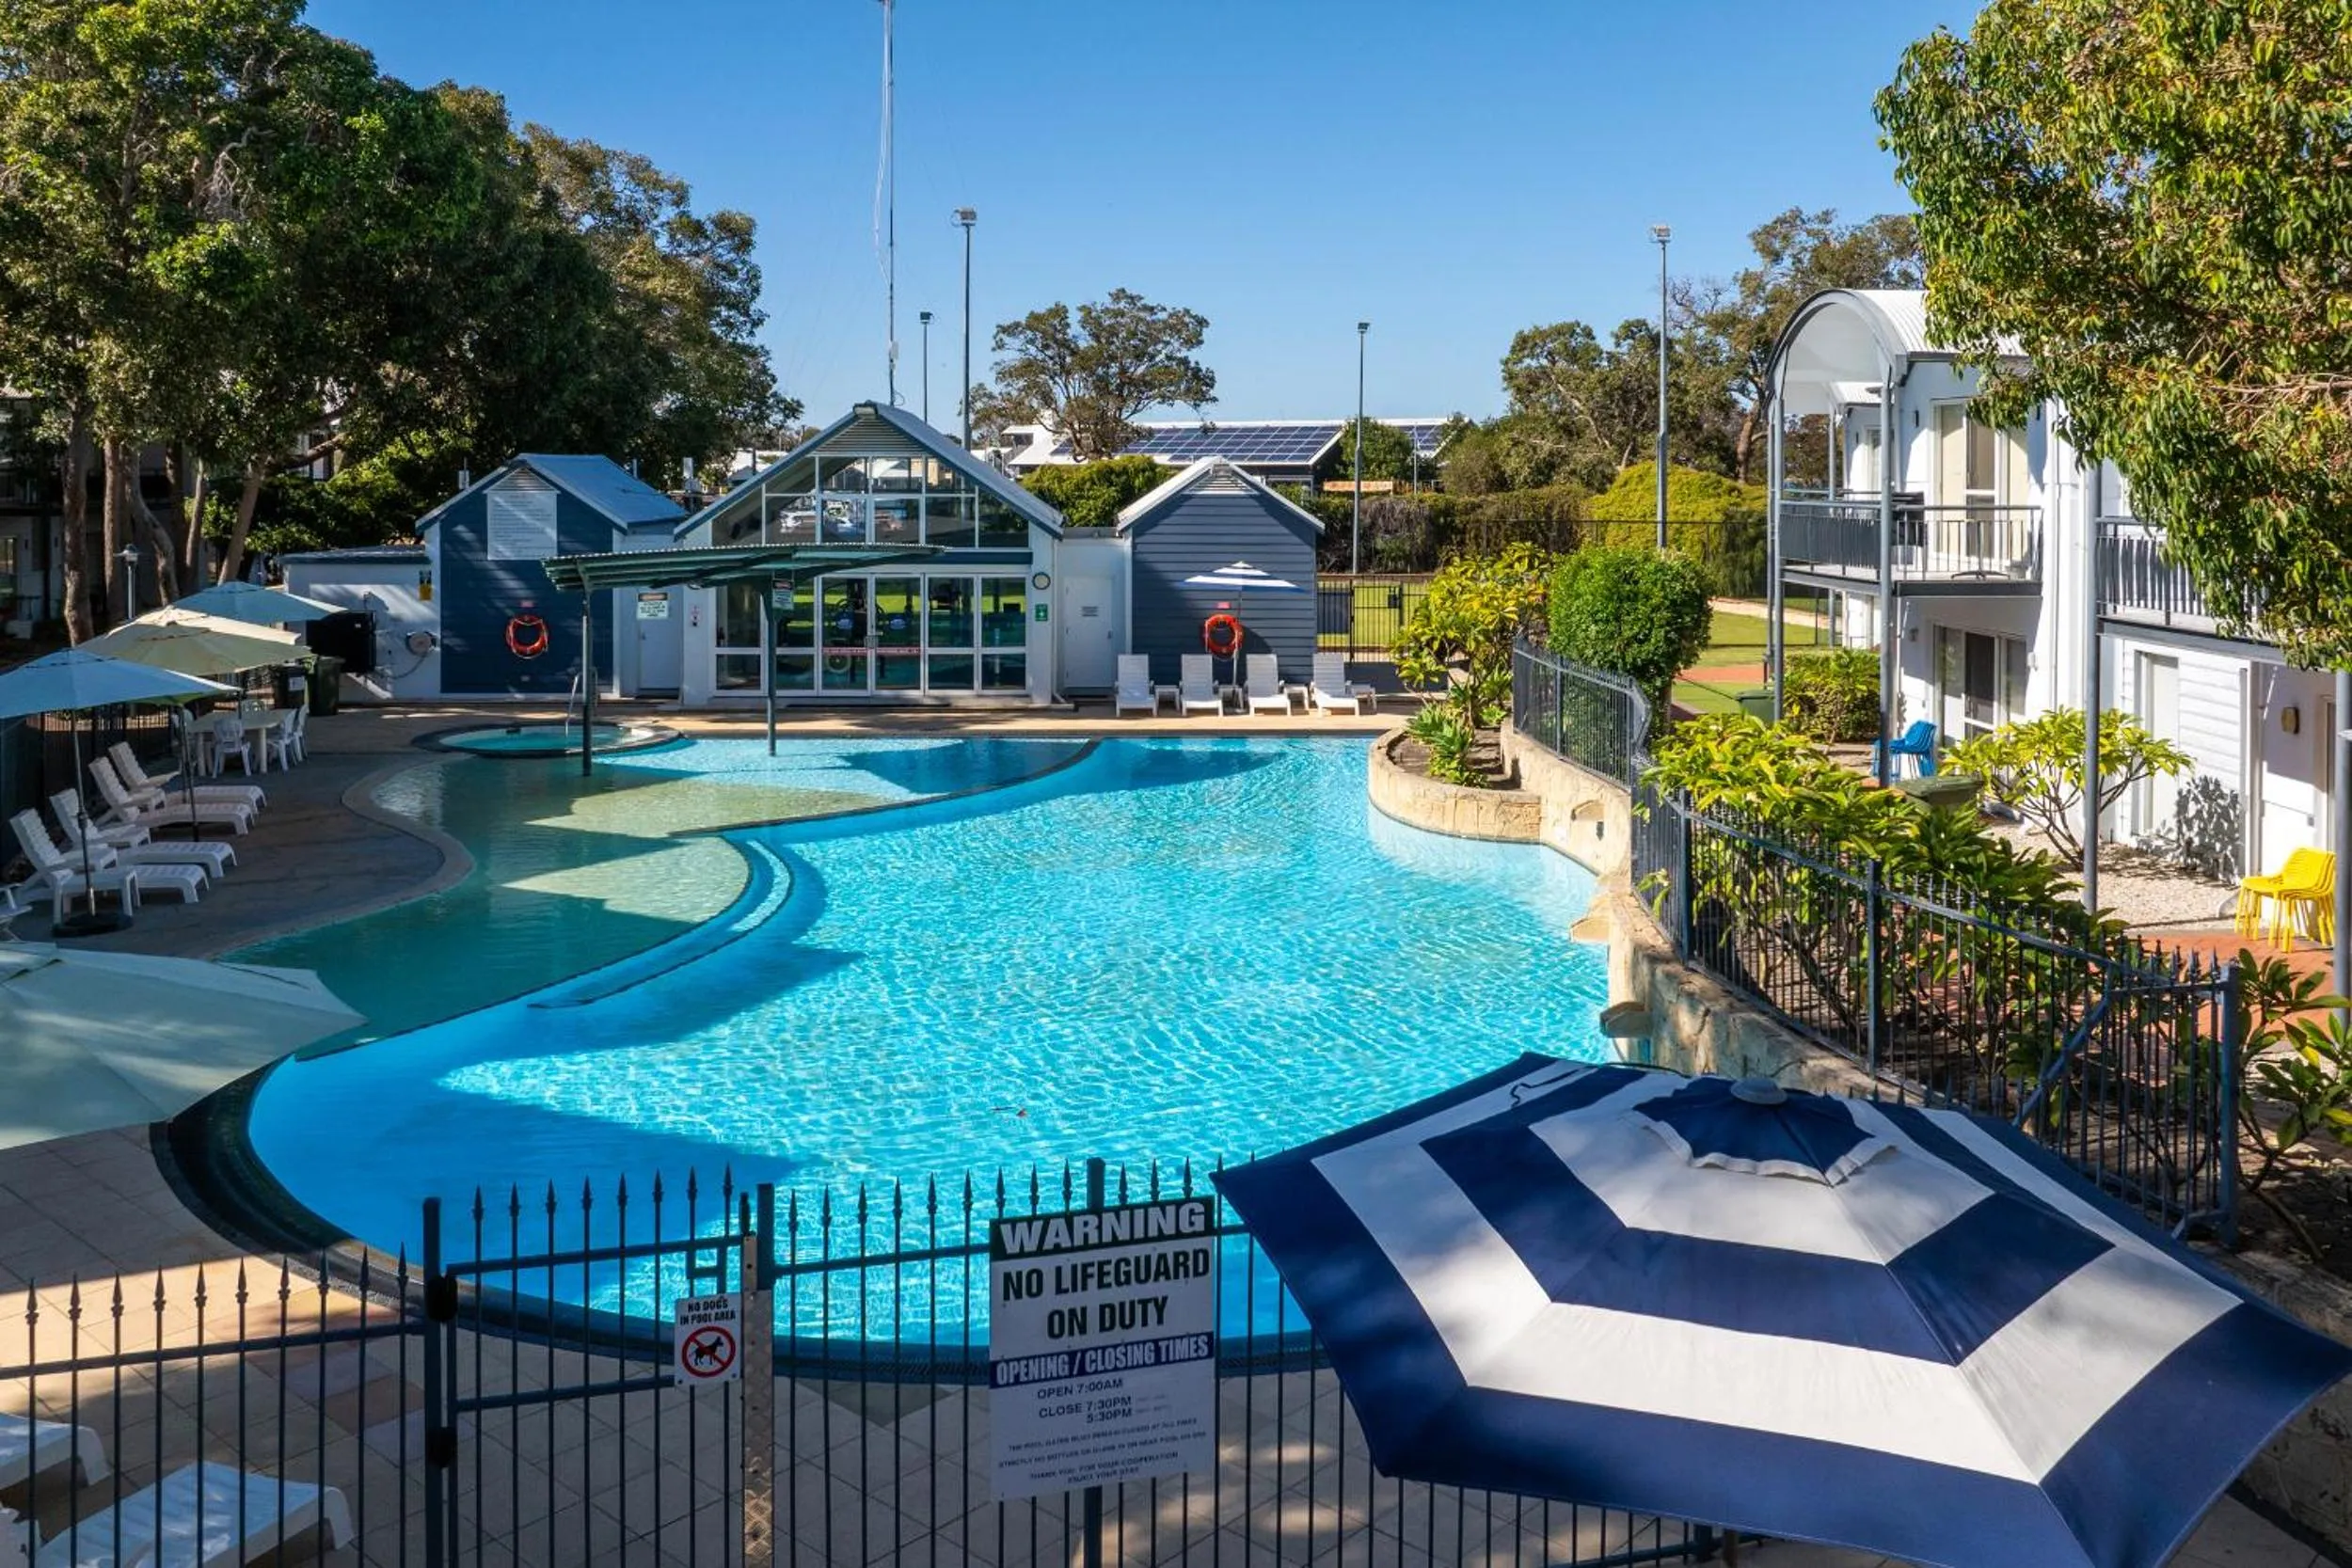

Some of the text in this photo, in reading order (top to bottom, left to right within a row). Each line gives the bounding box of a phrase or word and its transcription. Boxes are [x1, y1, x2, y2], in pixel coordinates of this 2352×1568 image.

[1000, 1202, 1205, 1255] WARNING
[1003, 1248, 1210, 1302] NO LIFEGUARD
[680, 1309, 736, 1325] IN POOL AREA
[688, 1299, 728, 1313] NO DOGS
[1047, 1295, 1168, 1339] ON DUTY
[996, 1354, 1069, 1385] OPENING
[1085, 1341, 1155, 1373] CLOSING
[1158, 1335, 1209, 1362] TIMES
[1038, 1378, 1123, 1400] OPEN 7:00AM
[1039, 1402, 1083, 1418] CLOSE
[1087, 1396, 1132, 1411] 7:30PM
